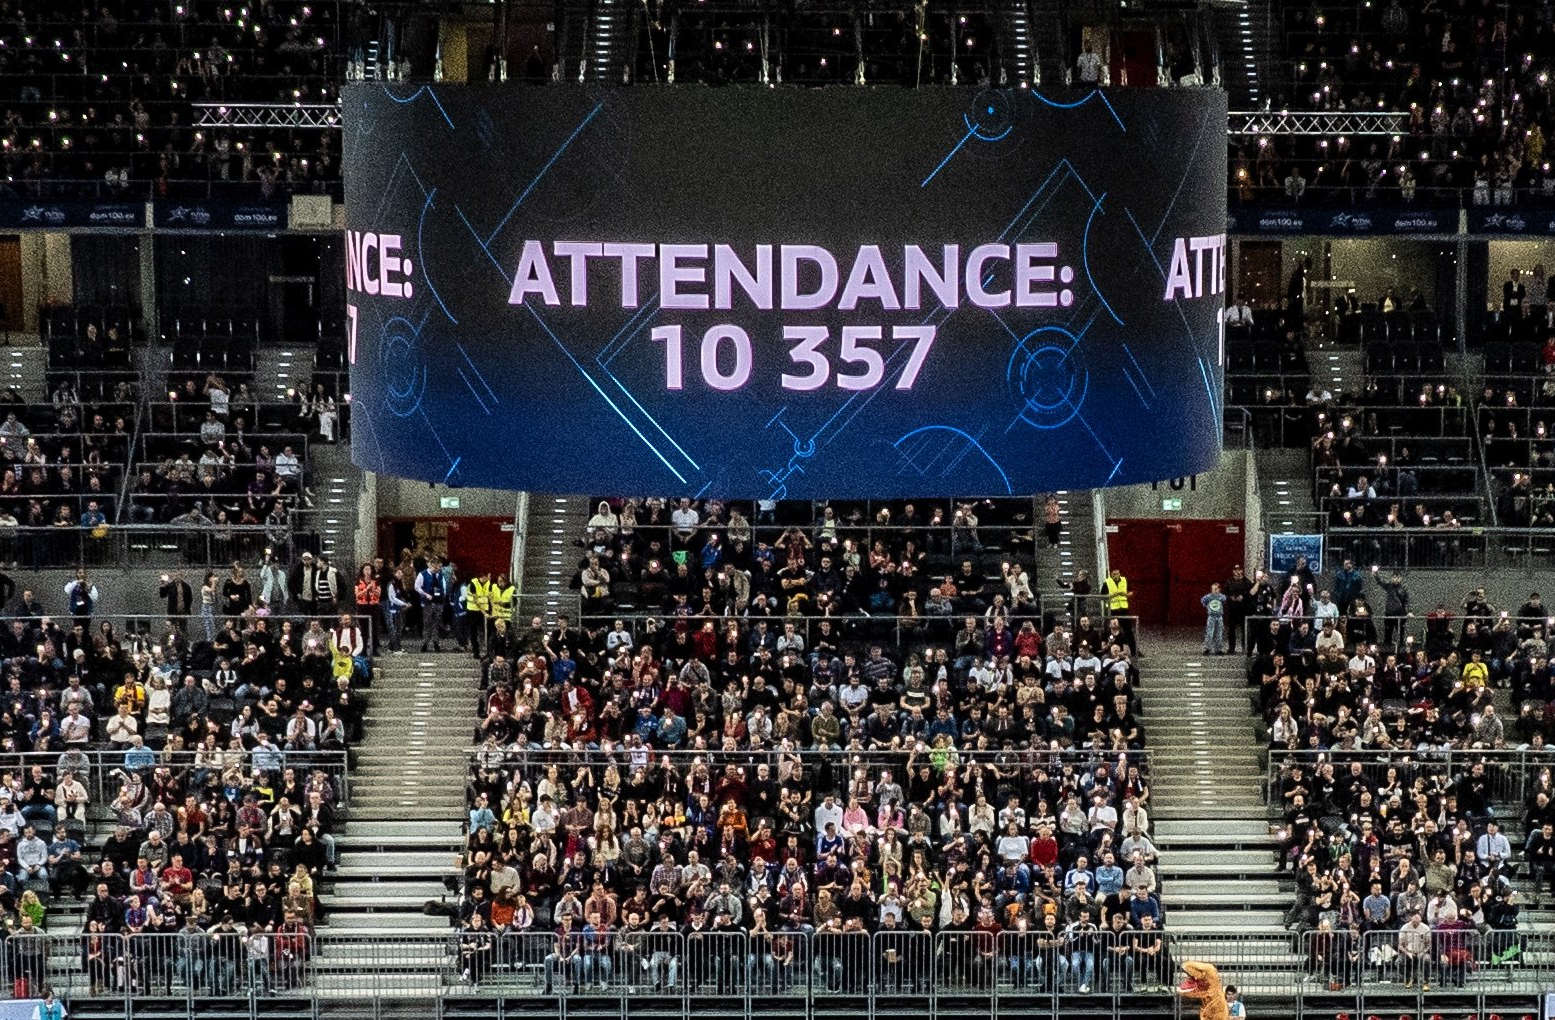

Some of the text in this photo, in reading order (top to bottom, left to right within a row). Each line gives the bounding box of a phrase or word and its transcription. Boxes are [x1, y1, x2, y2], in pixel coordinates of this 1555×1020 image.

[508, 240, 1074, 310] ATTENDANCE:
[651, 324, 937, 391] 10 357
